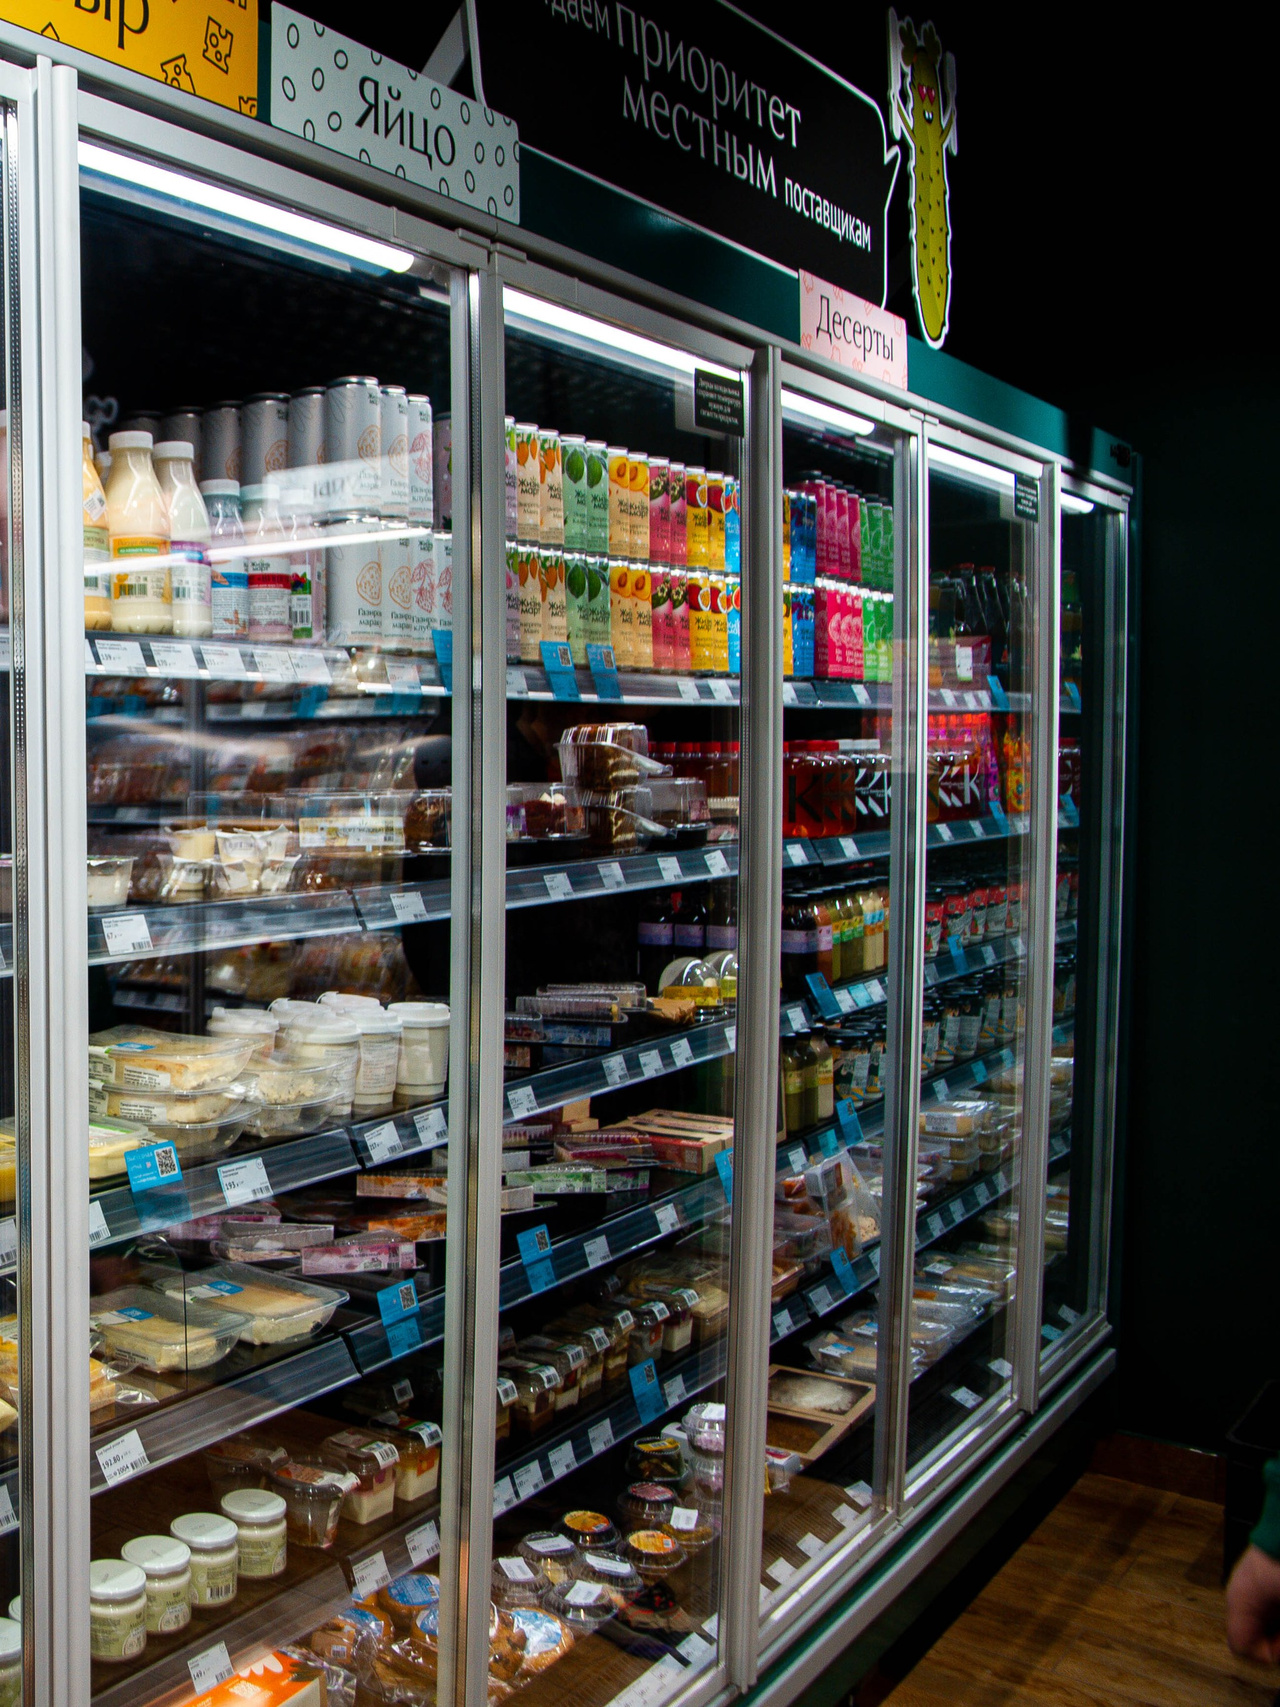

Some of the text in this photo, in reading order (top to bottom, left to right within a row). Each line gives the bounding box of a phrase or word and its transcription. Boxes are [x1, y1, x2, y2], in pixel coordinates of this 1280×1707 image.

[357, 75, 456, 171] Яйцо
[616, 2, 801, 148] приоритет
[623, 75, 871, 252] местным поставщикам
[816, 294, 894, 365] Десерты
[225, 1181, 236, 1191] 193
